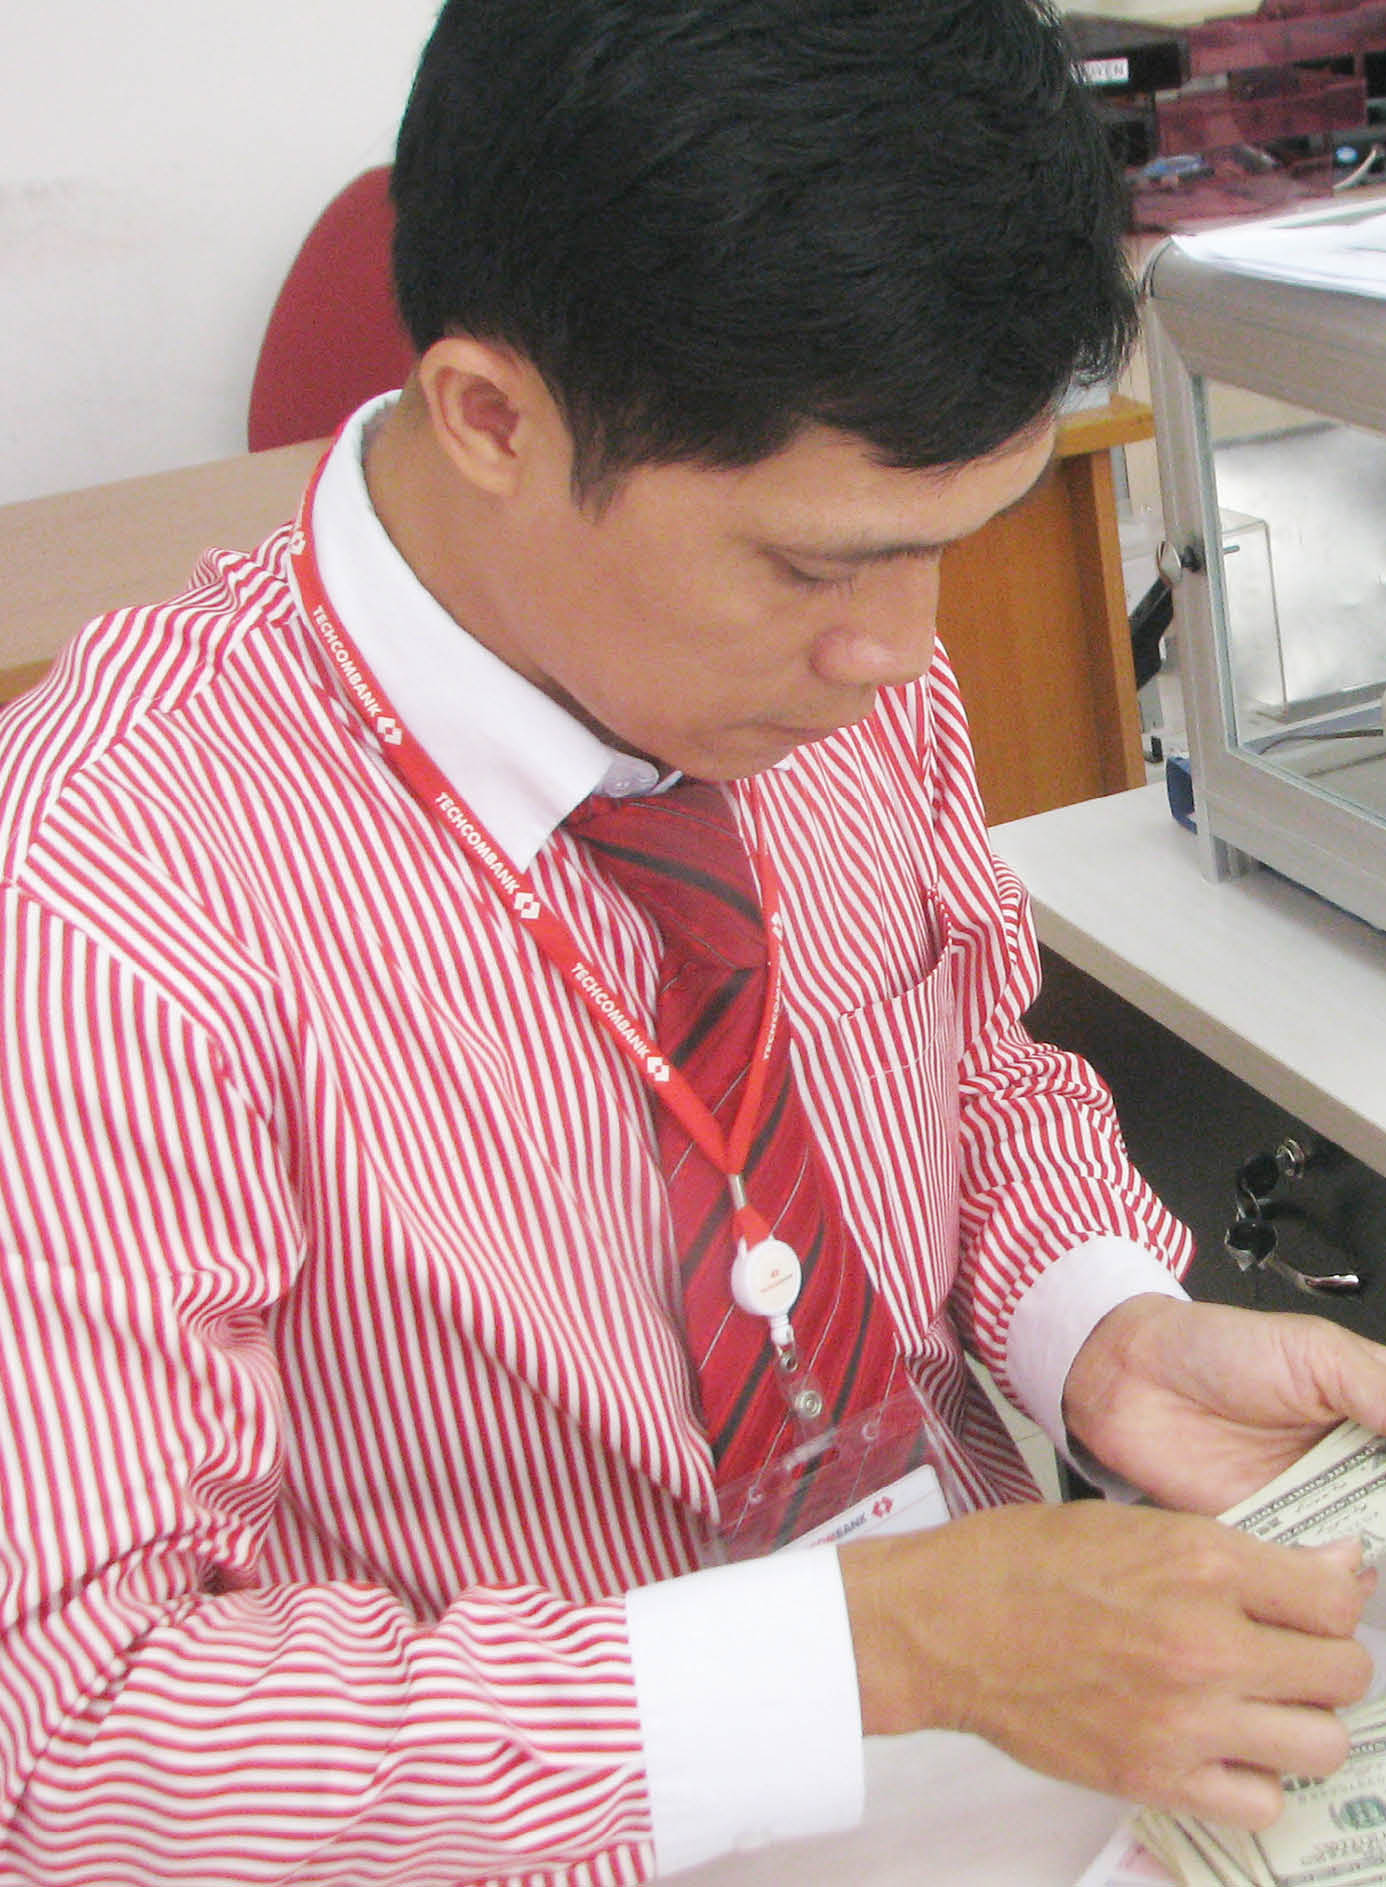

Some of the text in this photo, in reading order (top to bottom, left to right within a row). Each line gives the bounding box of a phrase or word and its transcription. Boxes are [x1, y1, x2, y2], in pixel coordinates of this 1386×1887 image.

[313, 604, 382, 718] TECHCOMBANK
[435, 791, 520, 895] TECHCOMBANK
[571, 962, 651, 1060] TECHCOMBANK
